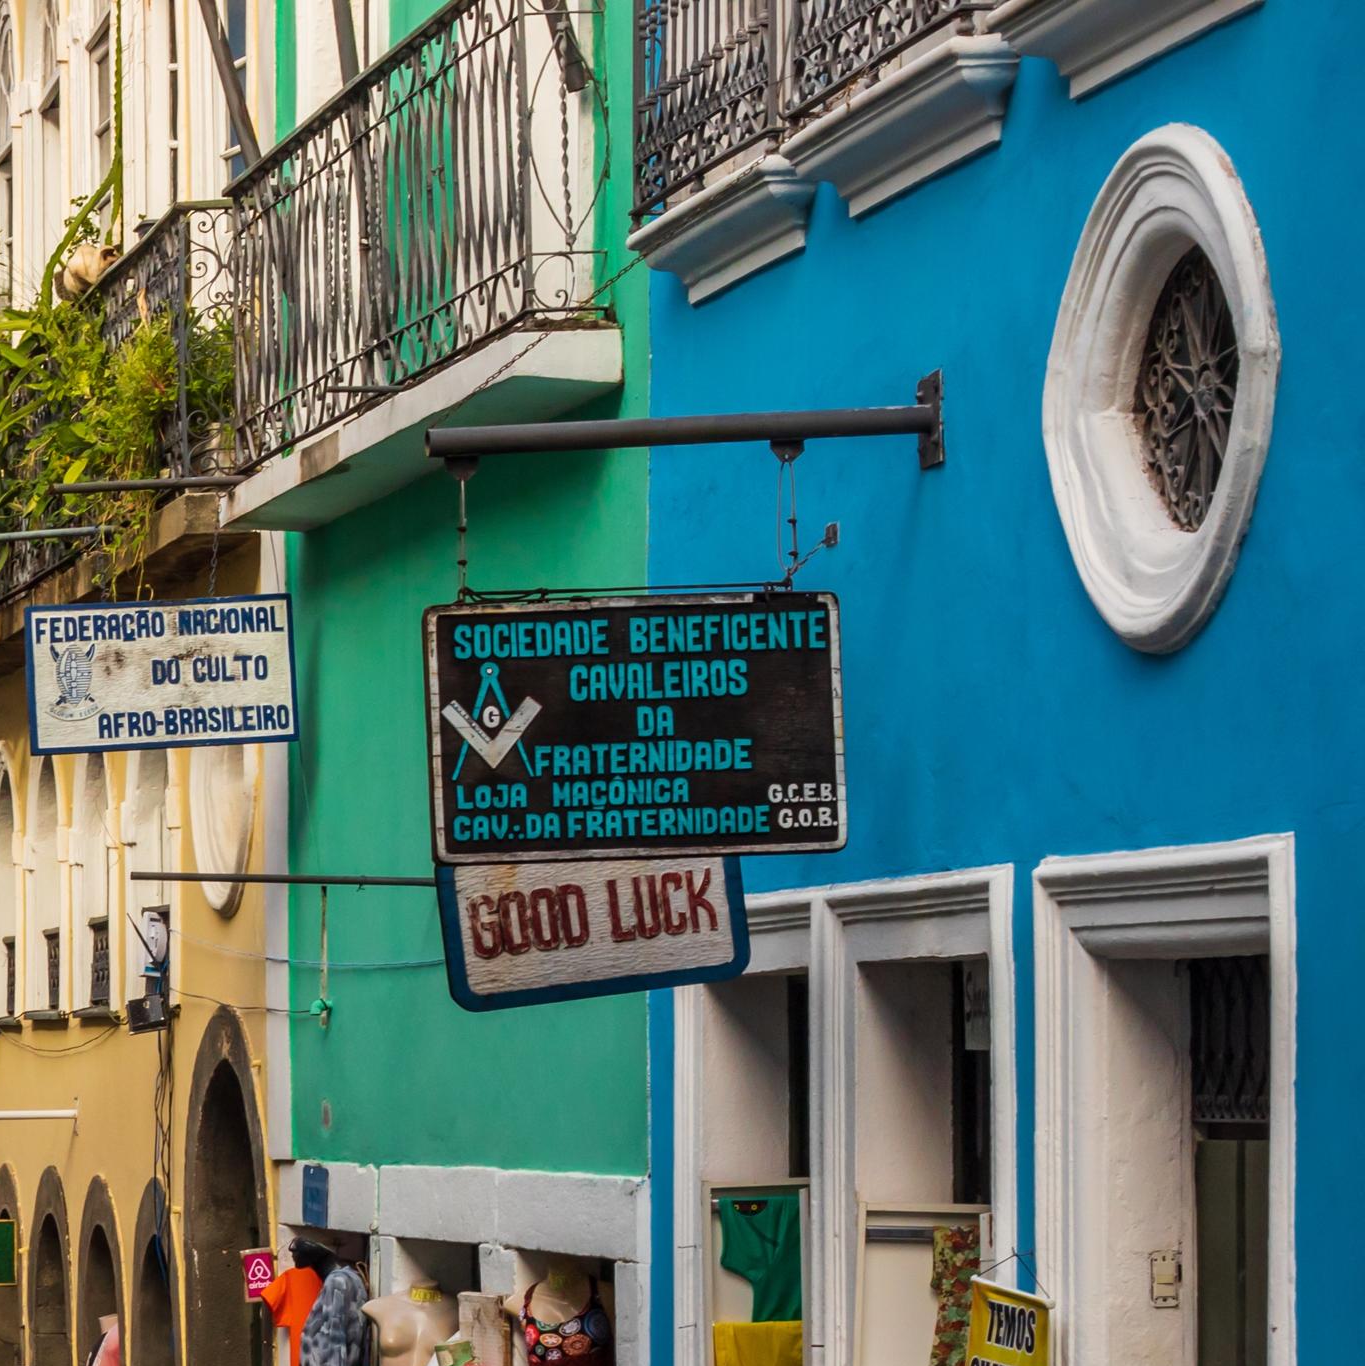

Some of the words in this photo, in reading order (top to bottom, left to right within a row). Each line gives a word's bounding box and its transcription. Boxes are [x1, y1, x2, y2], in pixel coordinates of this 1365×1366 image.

[35, 610, 165, 644] FEDERAÇÃO
[178, 606, 284, 636] NACIONAL
[453, 619, 609, 659] SOCIEDADE
[629, 610, 827, 654] BENEFICENTE
[151, 658, 180, 685] DO
[192, 655, 269, 683] CULTO
[570, 659, 748, 702] CAVALEIROS
[98, 704, 290, 739] AFRO-BRASILEIRO
[637, 706, 674, 738] DA
[535, 738, 752, 776] FRATERNIDADE
[456, 783, 527, 810] LOJA
[552, 776, 689, 811] MAÇÔNICA
[768, 783, 837, 804] G.C.E.B.
[568, 805, 770, 839] FRATERNIDADE
[778, 807, 838, 829] G.O.B.
[469, 885, 590, 959] GOOD
[606, 868, 719, 943] LUCK
[986, 1299, 1037, 1355] TEMOS
